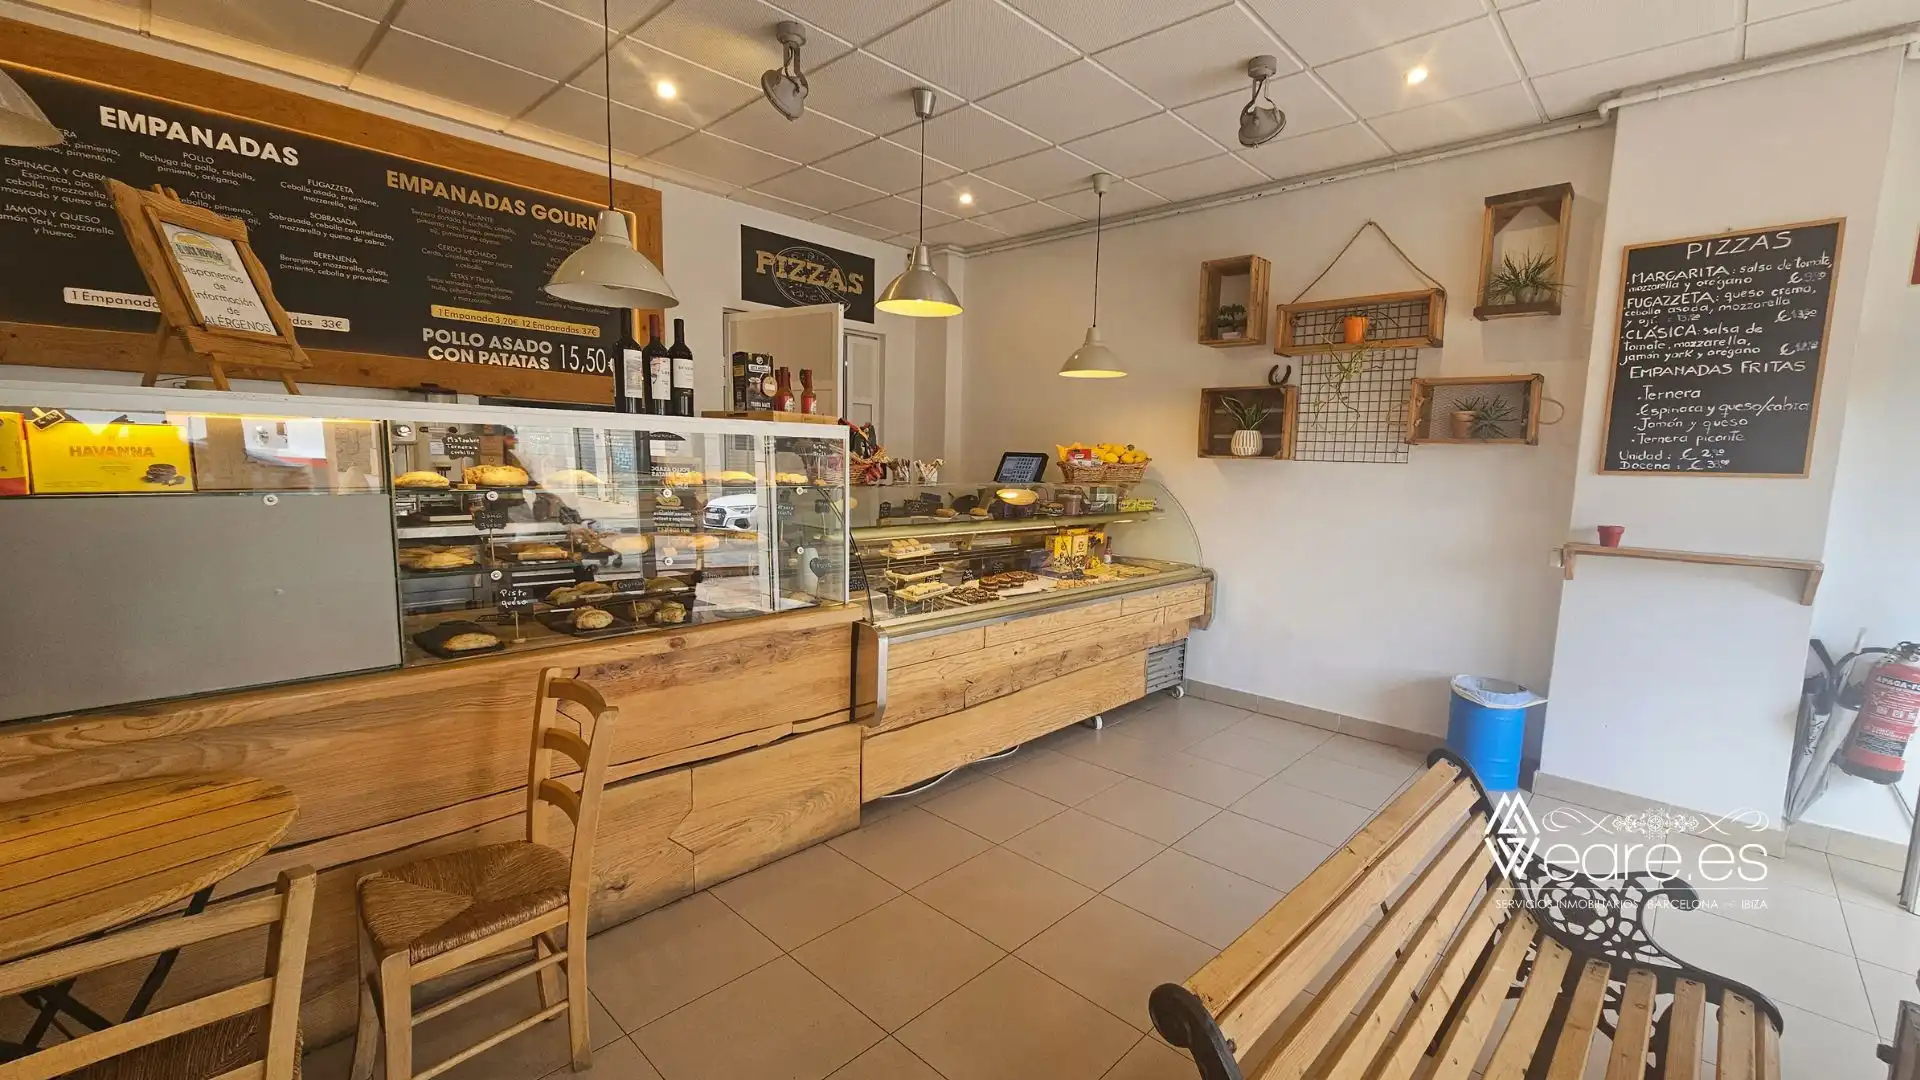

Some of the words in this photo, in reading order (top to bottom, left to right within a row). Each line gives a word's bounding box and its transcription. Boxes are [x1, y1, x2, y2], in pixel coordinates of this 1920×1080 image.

[99, 105, 299, 167] EMPANADAS
[139, 152, 178, 167] Pechuga
[180, 160, 192, 169] de
[182, 152, 215, 164] POLLO
[4, 157, 60, 173] ESPINACA
[73, 169, 105, 181] CABRA
[280, 181, 312, 193] Cebolla
[307, 178, 354, 194] FUGAZZETA
[386, 169, 527, 217] EMPANADAS
[62, 196, 92, 207] queso
[189, 190, 216, 201] ATÚN
[179, 198, 212, 209] ebolla,
[4, 203, 47, 216] JAMÓN
[60, 212, 100, 225] QUESO
[309, 212, 358, 227] SOBRASADA
[60, 222, 114, 235] mozzarella
[279, 224, 322, 236] mozzarella
[315, 222, 343, 232] cebolla
[437, 243, 462, 254] CERDO
[463, 248, 498, 260] MECHADO
[1686, 231, 1792, 260] PIZZAS
[313, 251, 358, 264] BERENJENA
[1777, 258, 1792, 270] de
[180, 264, 244, 284] Disponemos
[756, 250, 864, 295] PIZZAS
[213, 282, 228, 292] de
[1628, 281, 1680, 292] mozzarella
[1684, 282, 1691, 292] y
[192, 289, 256, 308] información
[1724, 289, 1764, 303] queso
[226, 307, 241, 316] de
[1624, 308, 1661, 317] cebolla
[1718, 297, 1791, 311] mozzarella
[321, 319, 343, 329] 33€
[444, 309, 494, 323] Empanada
[522, 320, 531, 328] 12
[533, 321, 579, 335] Empanadas
[581, 327, 598, 337] 37€
[1624, 319, 1633, 328] y
[1703, 321, 1740, 335] salsa
[1745, 322, 1763, 334] de
[422, 327, 485, 348] POLLO
[488, 335, 553, 355] ASADO
[428, 345, 475, 364] CON
[478, 349, 550, 370] PATATAS
[1696, 352, 1704, 360] y
[1630, 363, 1733, 379] EMPANADAS
[1741, 360, 1806, 374] FRITAS
[1642, 384, 1702, 400] Ternera
[1640, 404, 1703, 419] Espinaca
[1706, 405, 1716, 417] y
[1686, 421, 1697, 433] y
[1703, 418, 1748, 434] queso
[1636, 433, 1688, 445] Ternera
[1696, 430, 1745, 446] picante
[69, 445, 155, 458] HAVANNA
